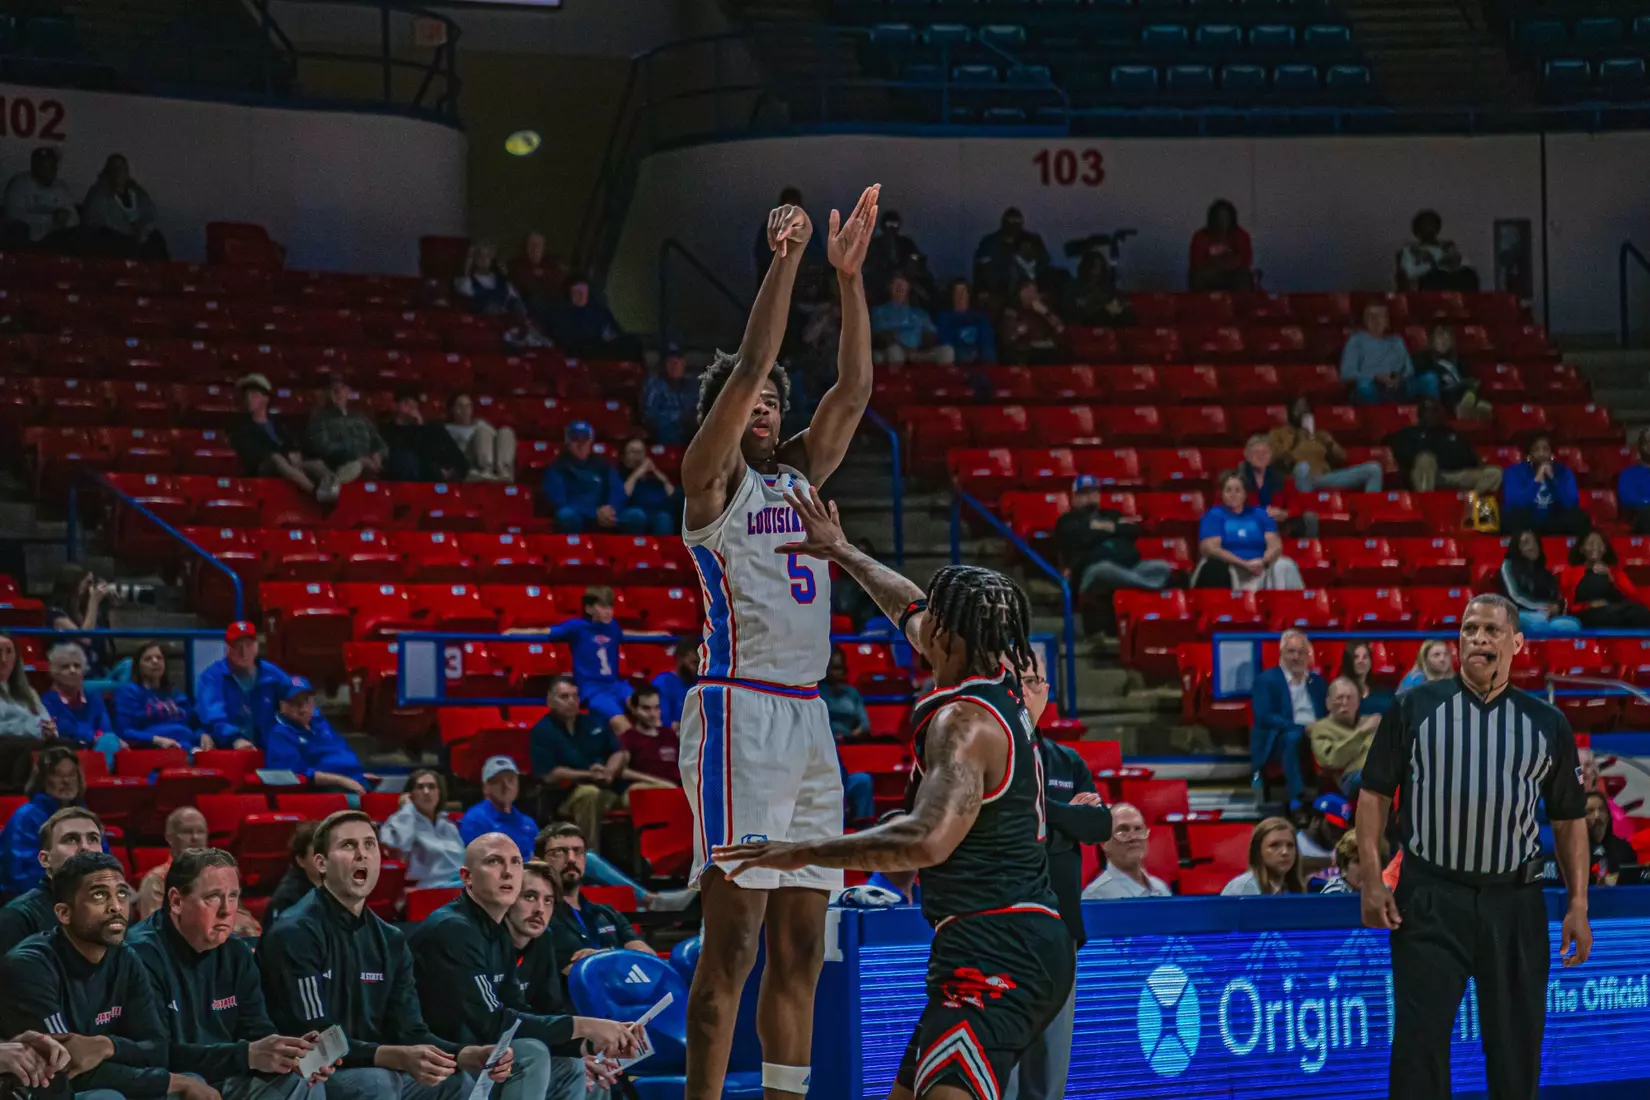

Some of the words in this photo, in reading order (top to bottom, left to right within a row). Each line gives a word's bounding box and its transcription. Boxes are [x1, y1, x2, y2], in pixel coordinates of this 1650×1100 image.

[1033, 148, 1104, 187] 103
[787, 541, 817, 605] 5
[444, 647, 462, 679] 3
[596, 647, 612, 676] 1
[1582, 974, 1648, 1011] Official
[1219, 976, 1369, 1073] Origin
